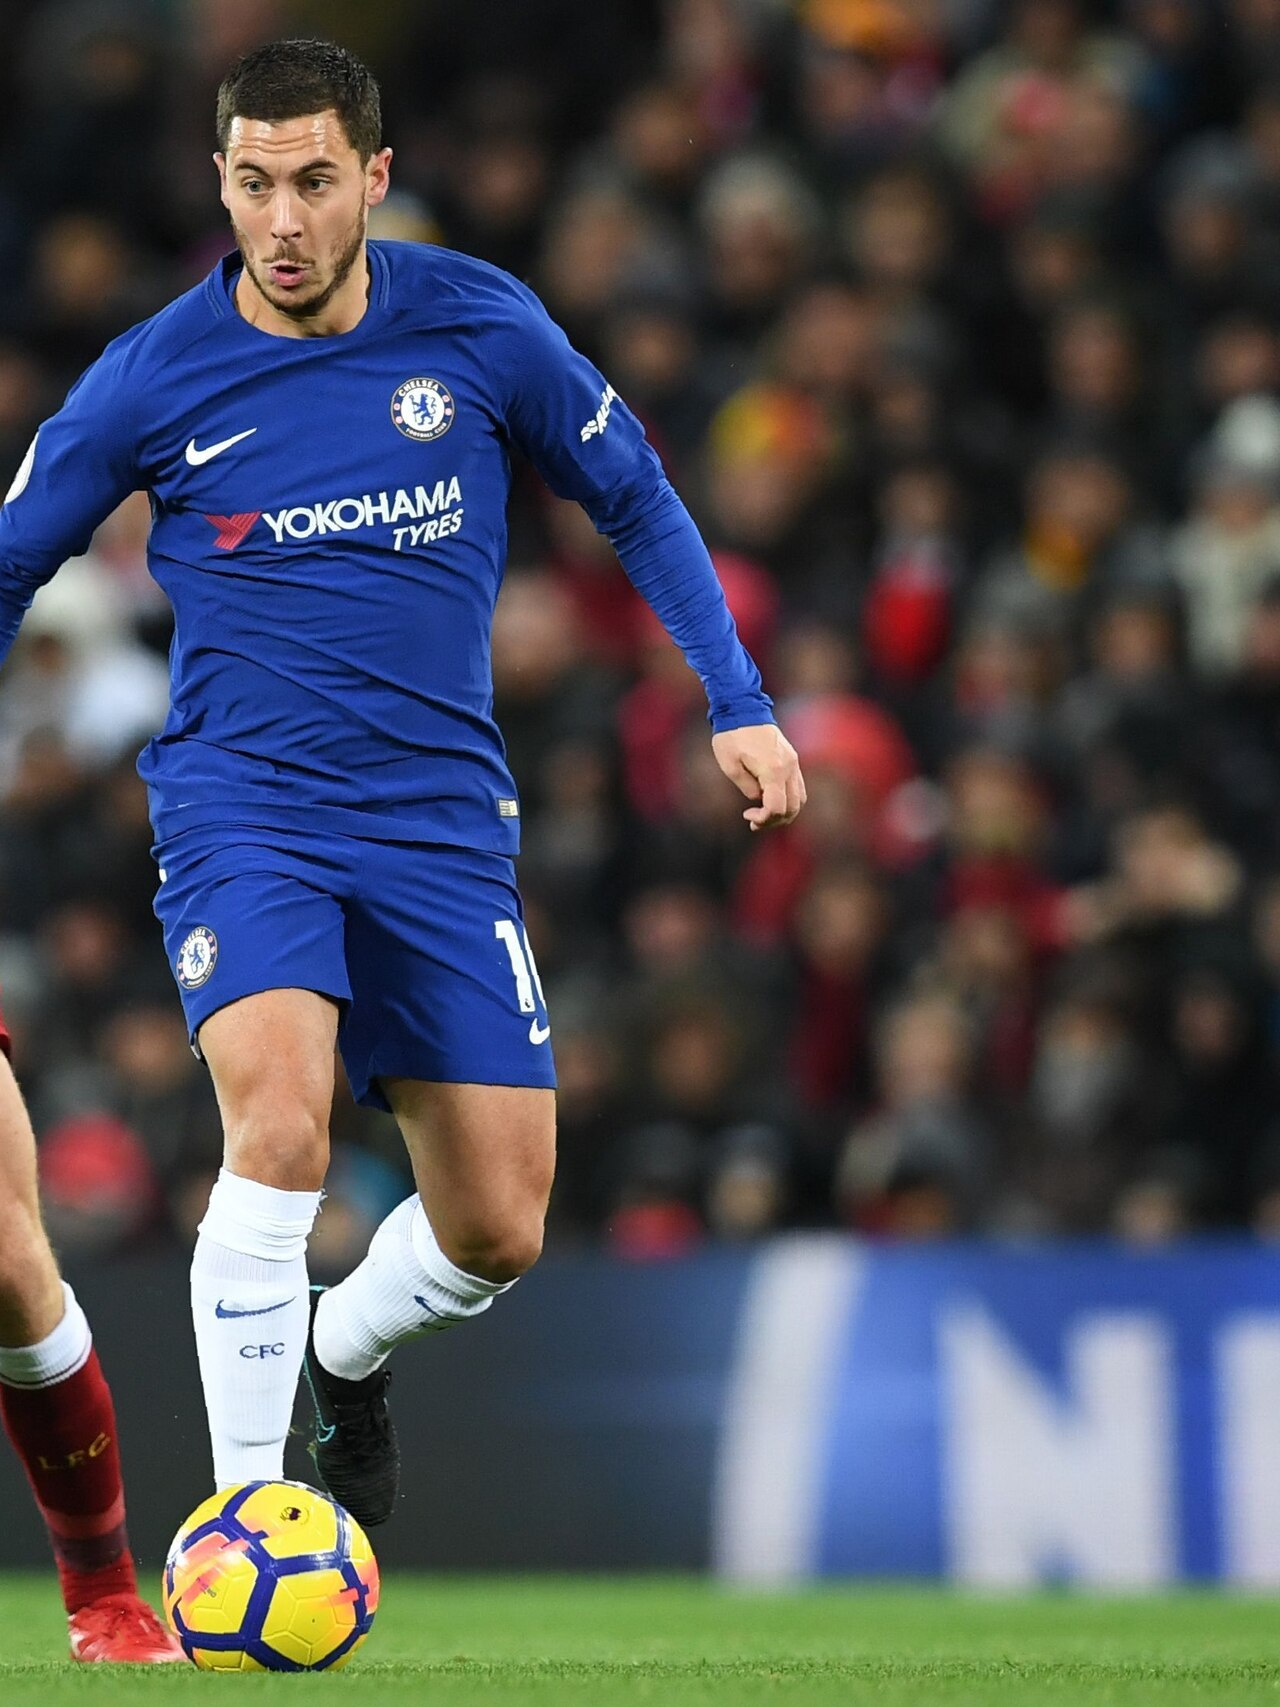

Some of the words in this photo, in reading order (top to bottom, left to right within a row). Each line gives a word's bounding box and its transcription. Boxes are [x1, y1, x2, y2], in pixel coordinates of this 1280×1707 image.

[398, 380, 439, 397] CHELSEA
[261, 476, 462, 543] YOKOHAMA
[392, 508, 464, 551] TYRES
[239, 1342, 285, 1359] CFC
[38, 1431, 112, 1470] LFC
